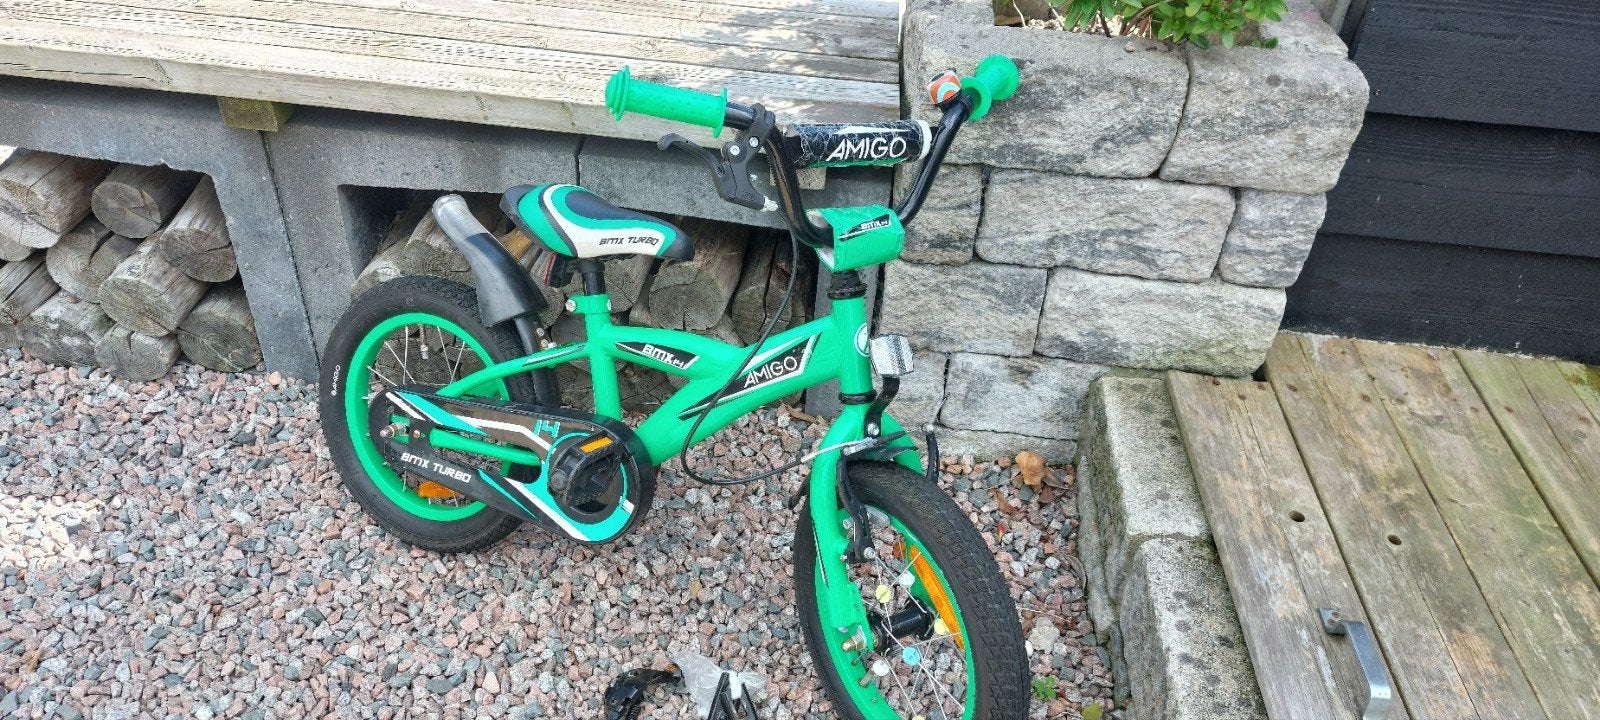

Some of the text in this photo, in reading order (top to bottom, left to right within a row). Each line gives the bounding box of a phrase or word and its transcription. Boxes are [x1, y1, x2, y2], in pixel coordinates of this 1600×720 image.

[825, 136, 907, 161] AMIGO
[599, 236, 659, 246] BMX TURBO
[743, 356, 798, 388] AMIGO
[533, 419, 560, 438] 14
[400, 452, 472, 484] BMX TURBO
